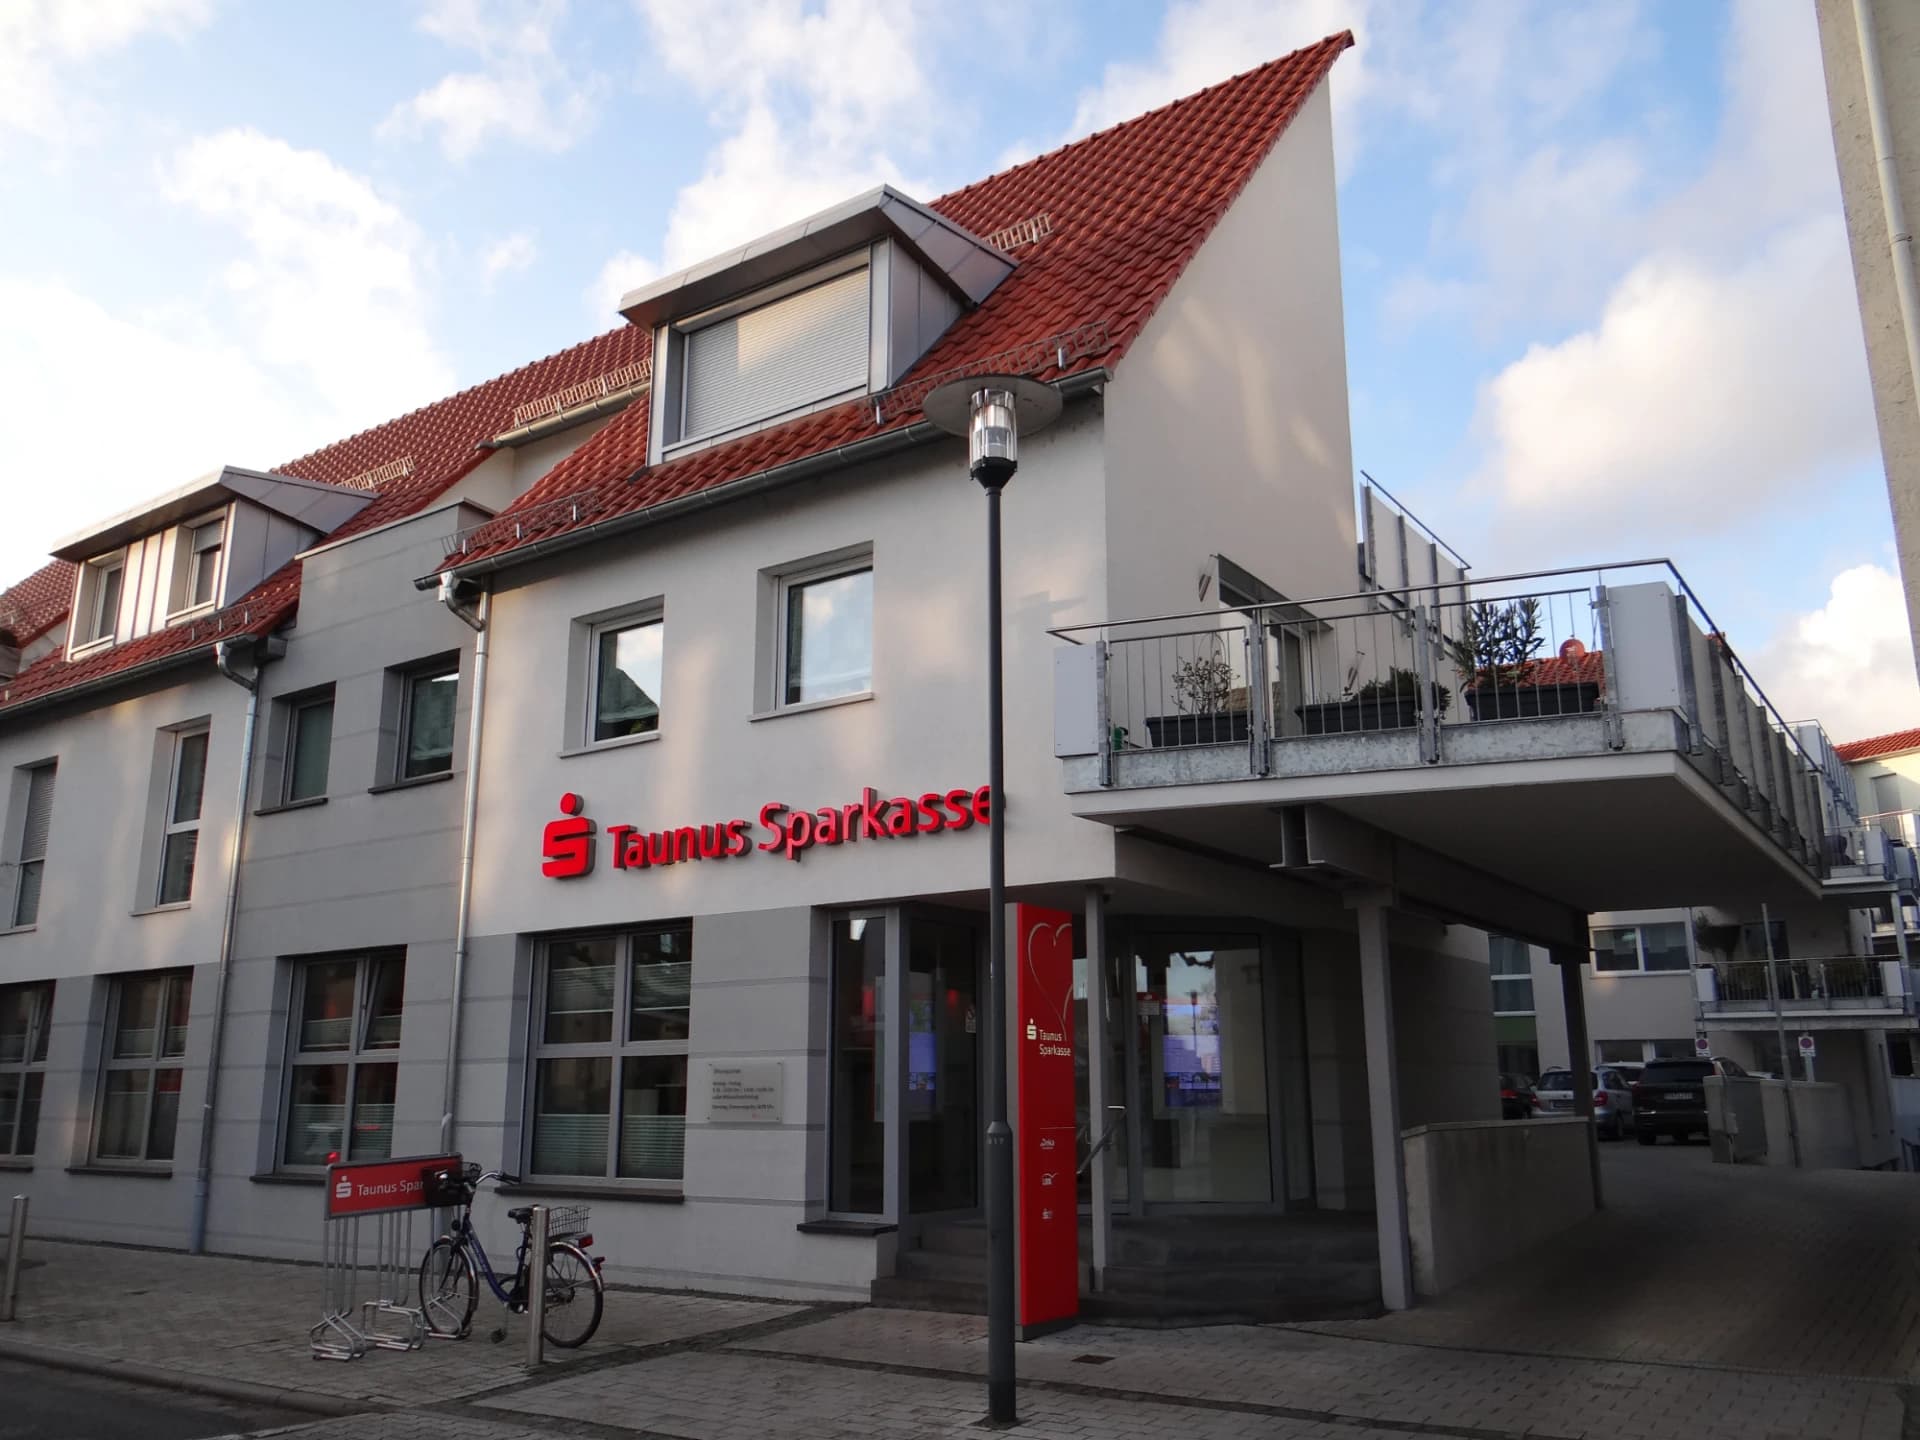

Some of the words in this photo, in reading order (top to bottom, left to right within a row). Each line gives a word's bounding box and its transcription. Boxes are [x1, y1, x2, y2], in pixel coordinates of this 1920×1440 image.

[607, 819, 752, 870] Taunus
[758, 785, 992, 861] Sparkasse
[1039, 1029, 1062, 1041] Taunus
[1039, 1044, 1071, 1056] Sparkasse
[357, 1184, 397, 1196] Taunus
